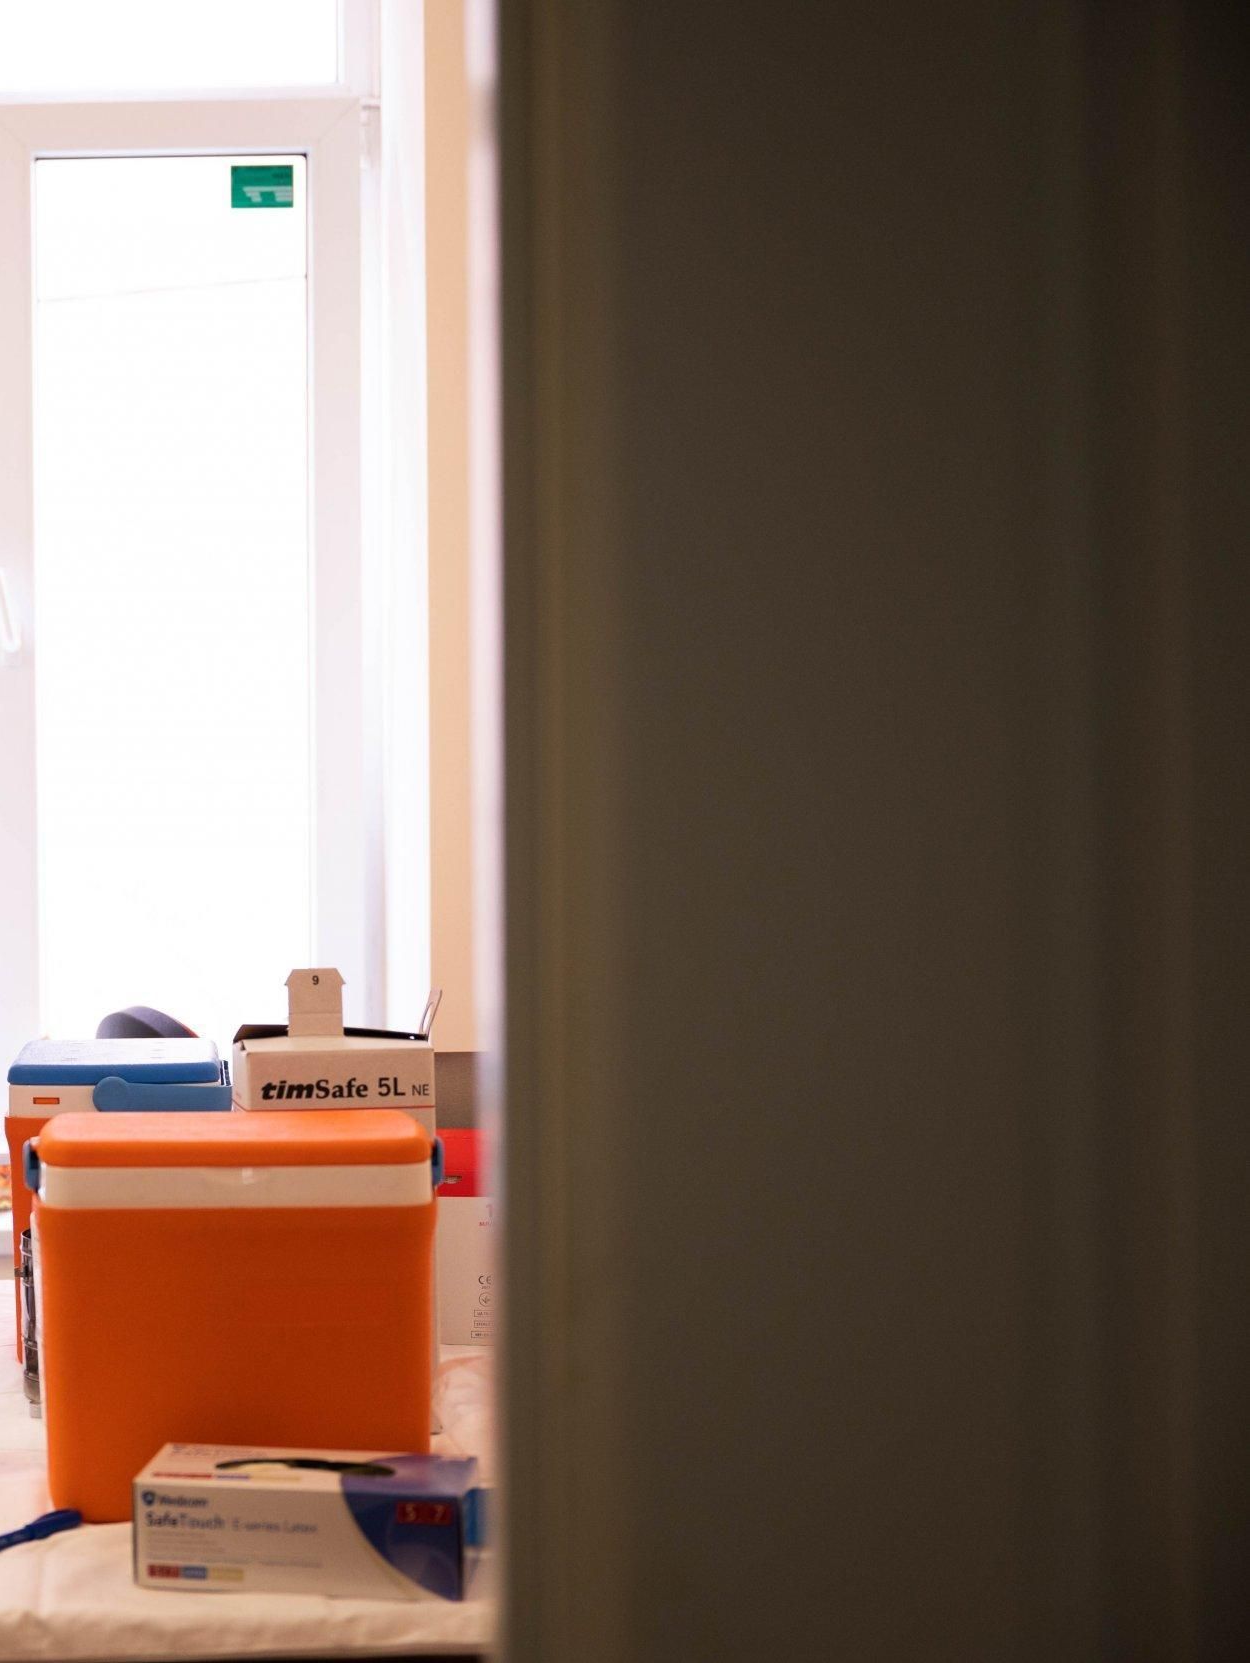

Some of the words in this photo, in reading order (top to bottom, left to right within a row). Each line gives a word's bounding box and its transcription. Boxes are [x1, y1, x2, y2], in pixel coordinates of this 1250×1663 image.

[312, 975, 319, 986] 9
[260, 1077, 369, 1100] timSafe
[377, 1077, 406, 1097] 5L
[411, 1084, 430, 1096] NE
